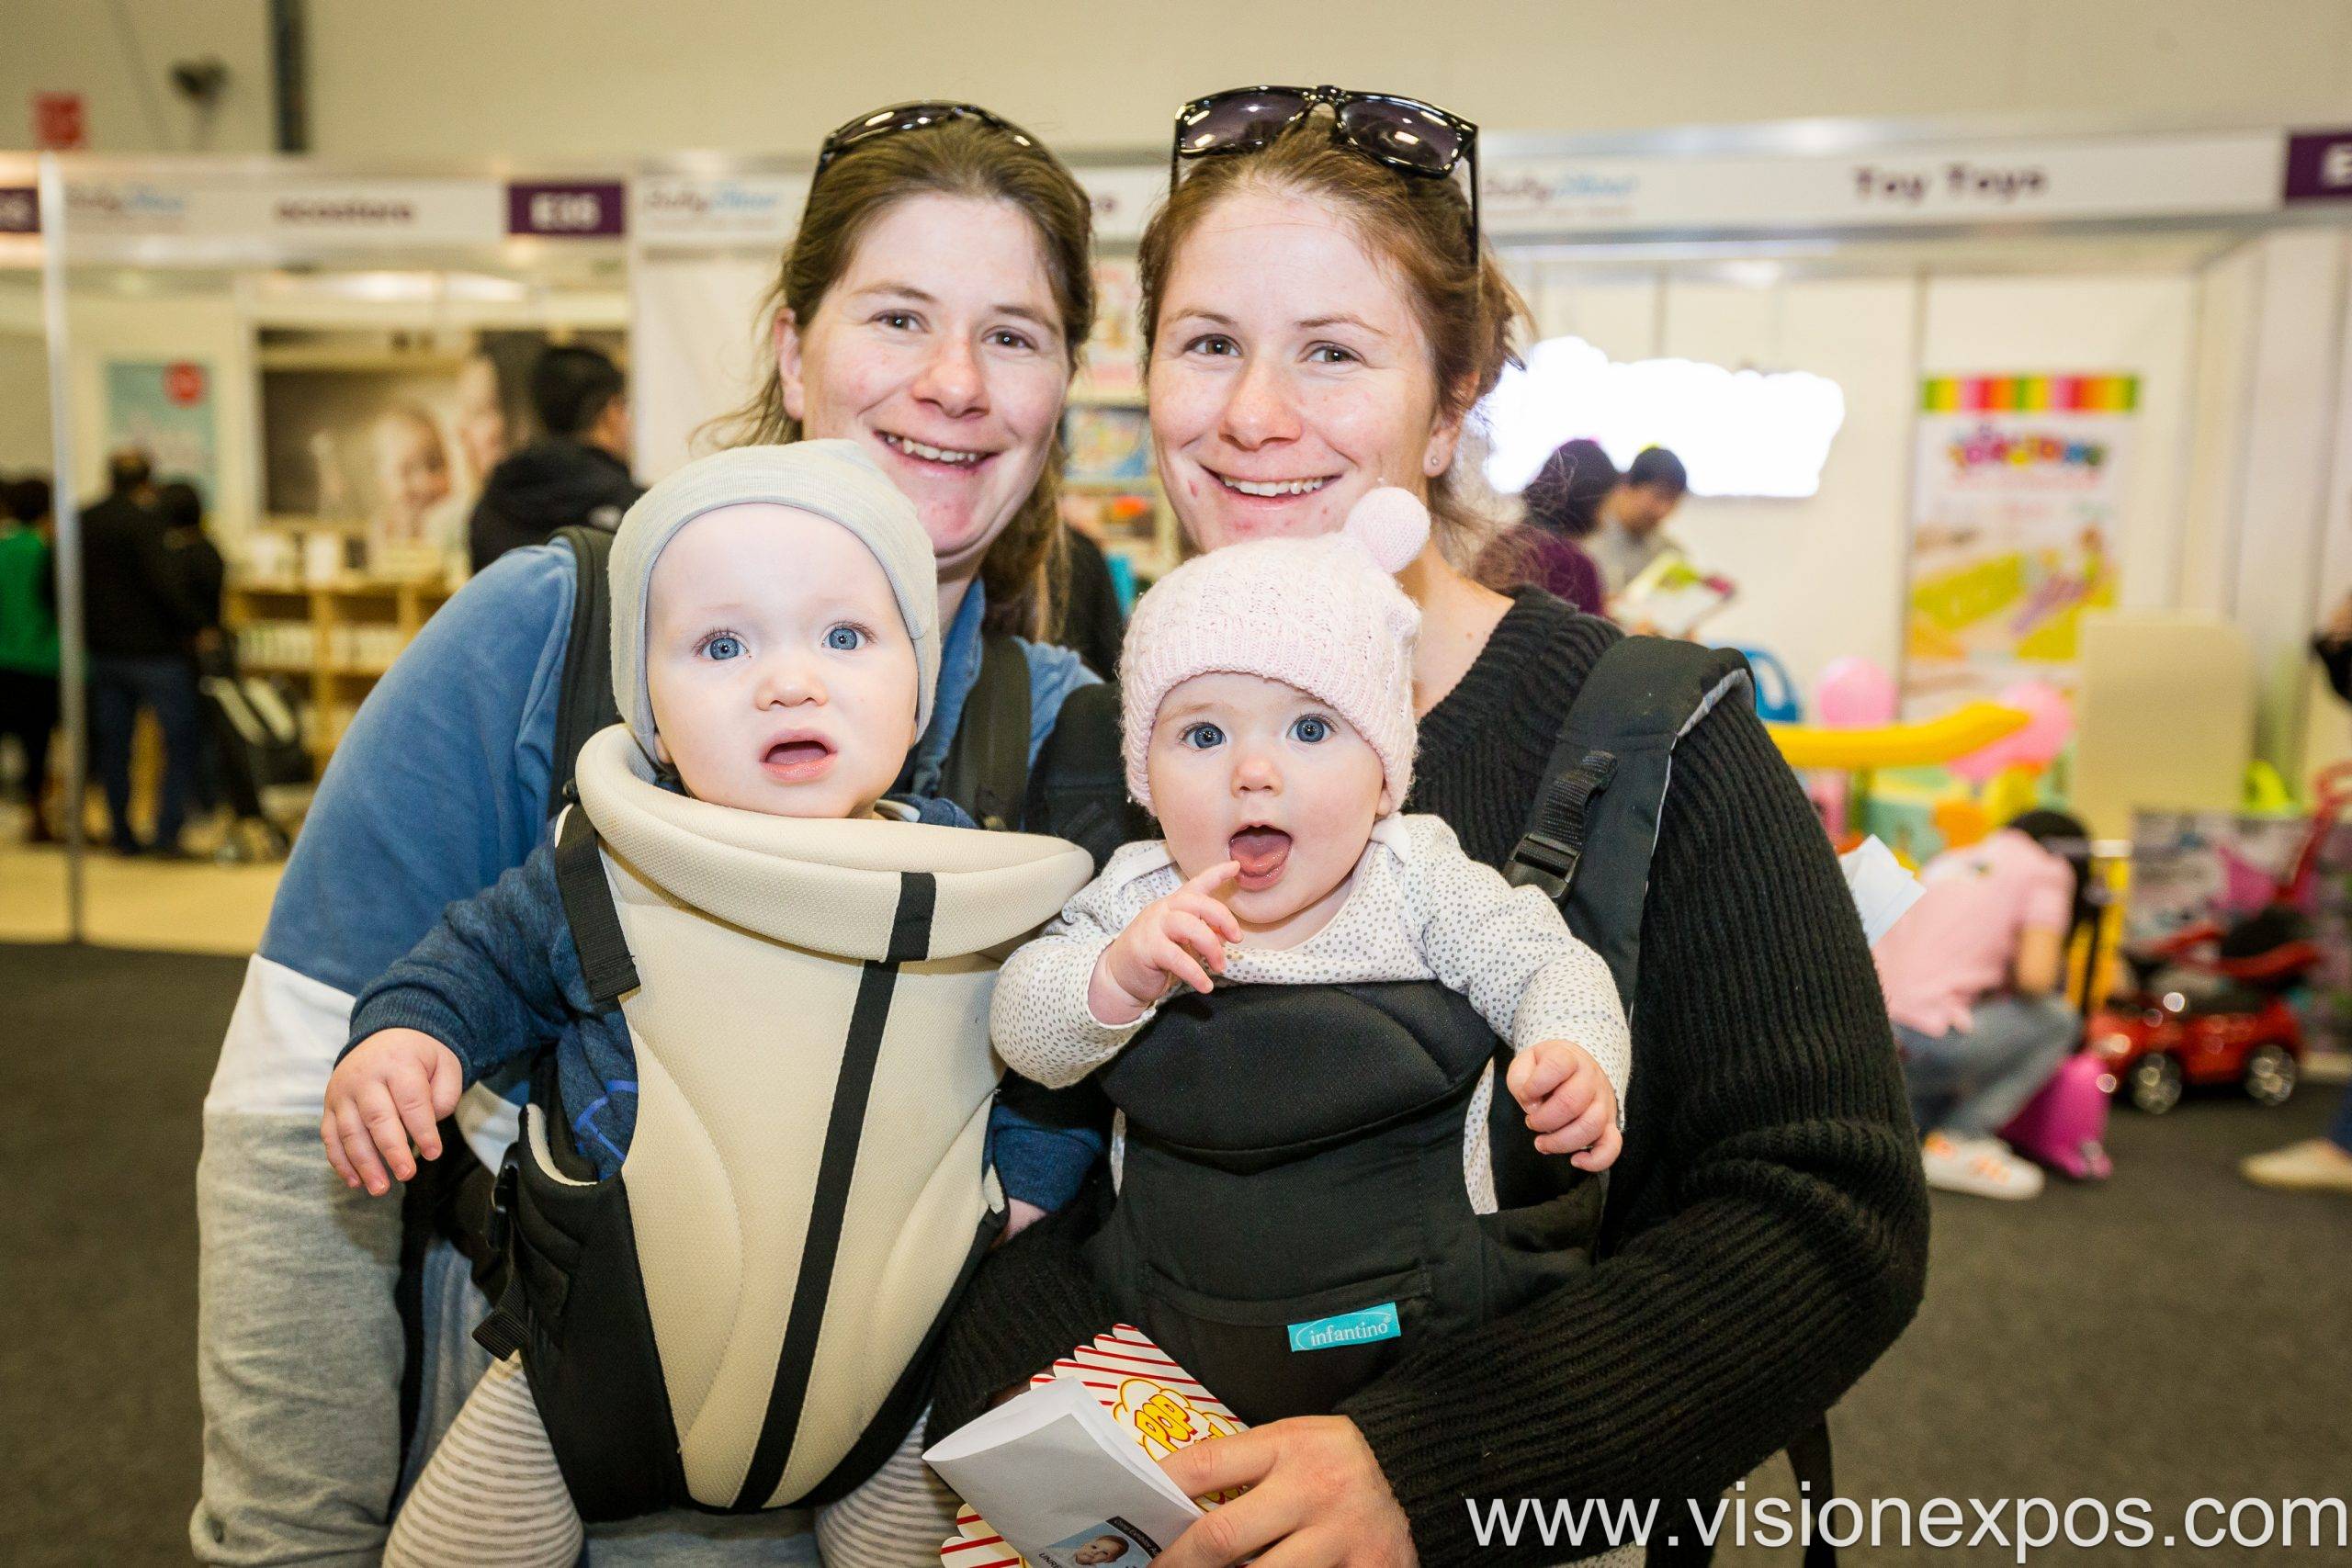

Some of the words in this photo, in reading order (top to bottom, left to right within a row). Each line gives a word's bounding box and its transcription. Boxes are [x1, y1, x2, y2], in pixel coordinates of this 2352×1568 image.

[1852, 164, 1928, 206] Toy
[1309, 1321, 1388, 1347] infantino
[1134, 1393, 1198, 1453] POP
